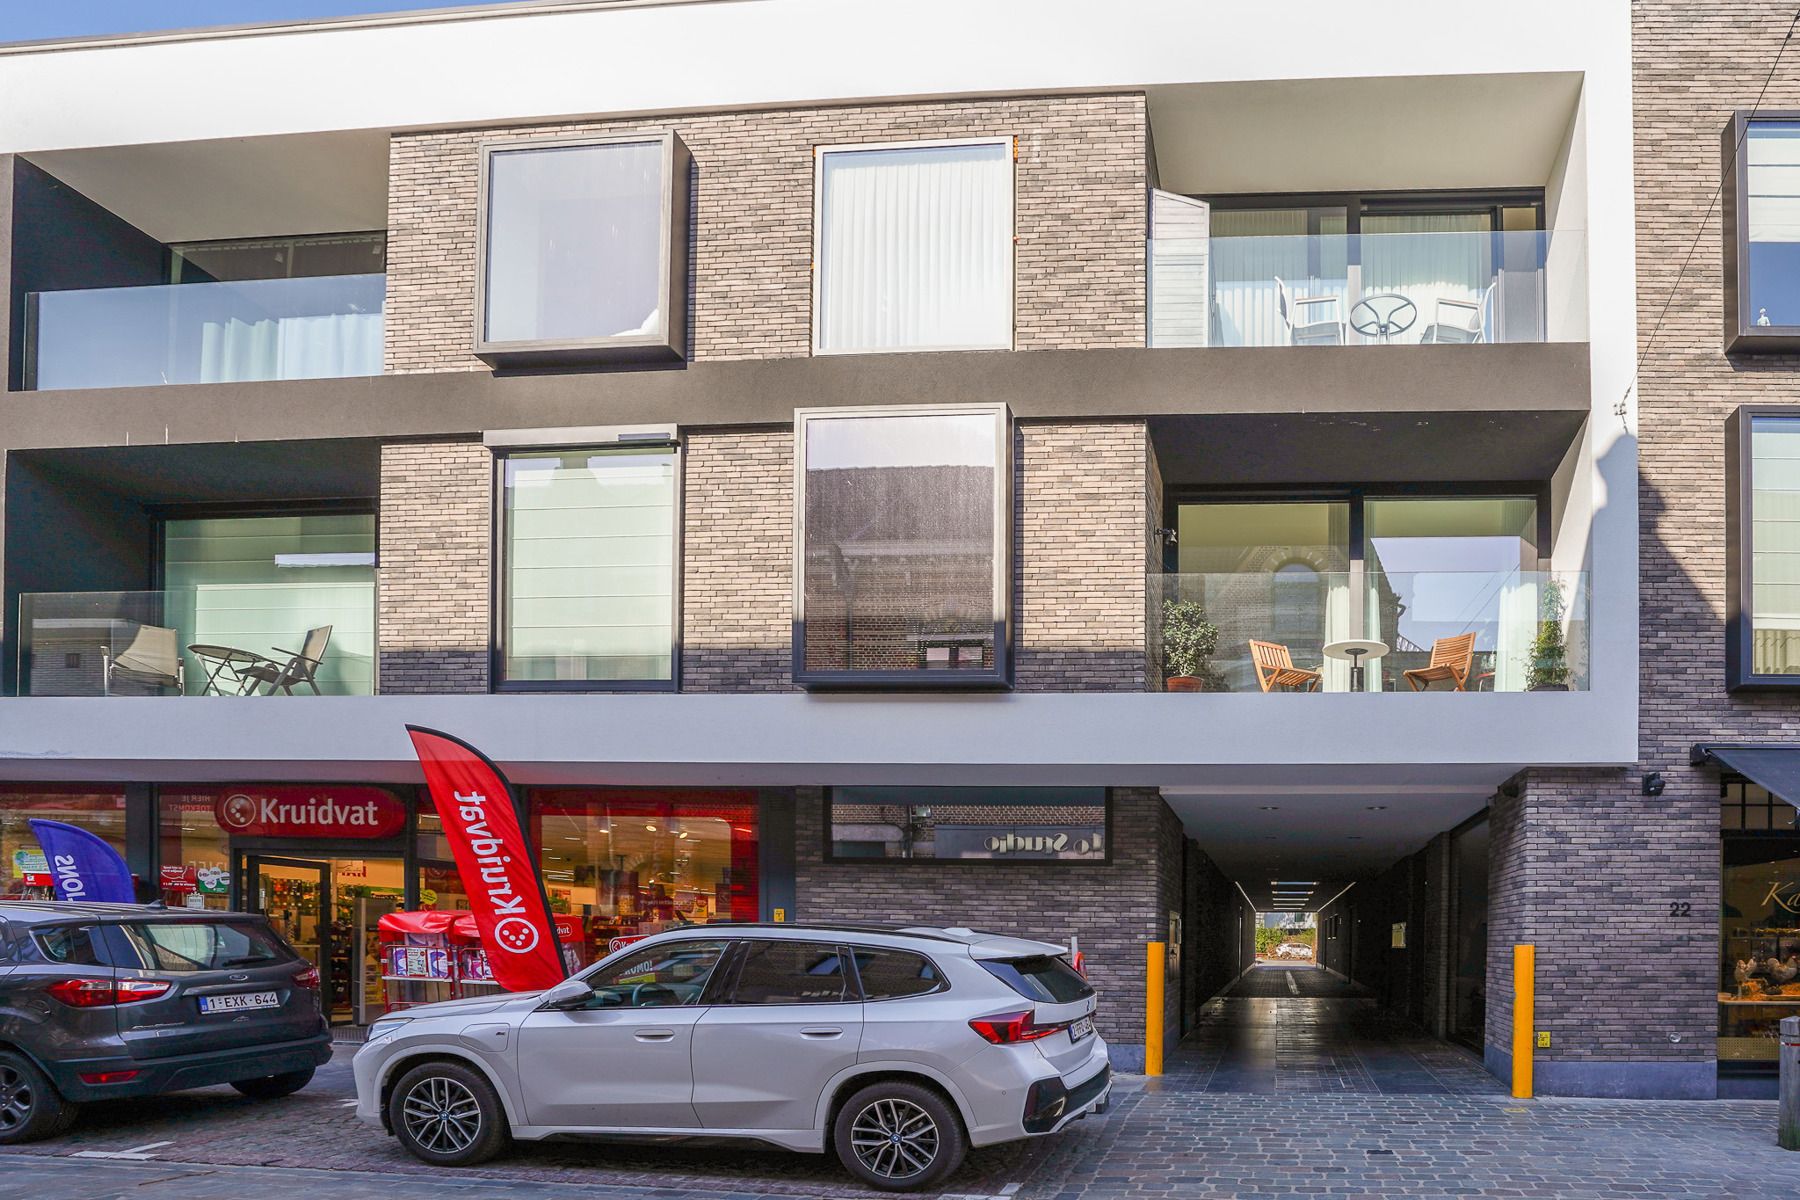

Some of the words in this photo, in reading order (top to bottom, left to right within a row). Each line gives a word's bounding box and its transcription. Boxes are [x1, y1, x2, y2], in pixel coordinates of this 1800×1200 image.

[260, 797, 379, 826] Kruidvat
[1669, 902, 1691, 917] 22
[209, 993, 277, 1010] 1-EXK-644
